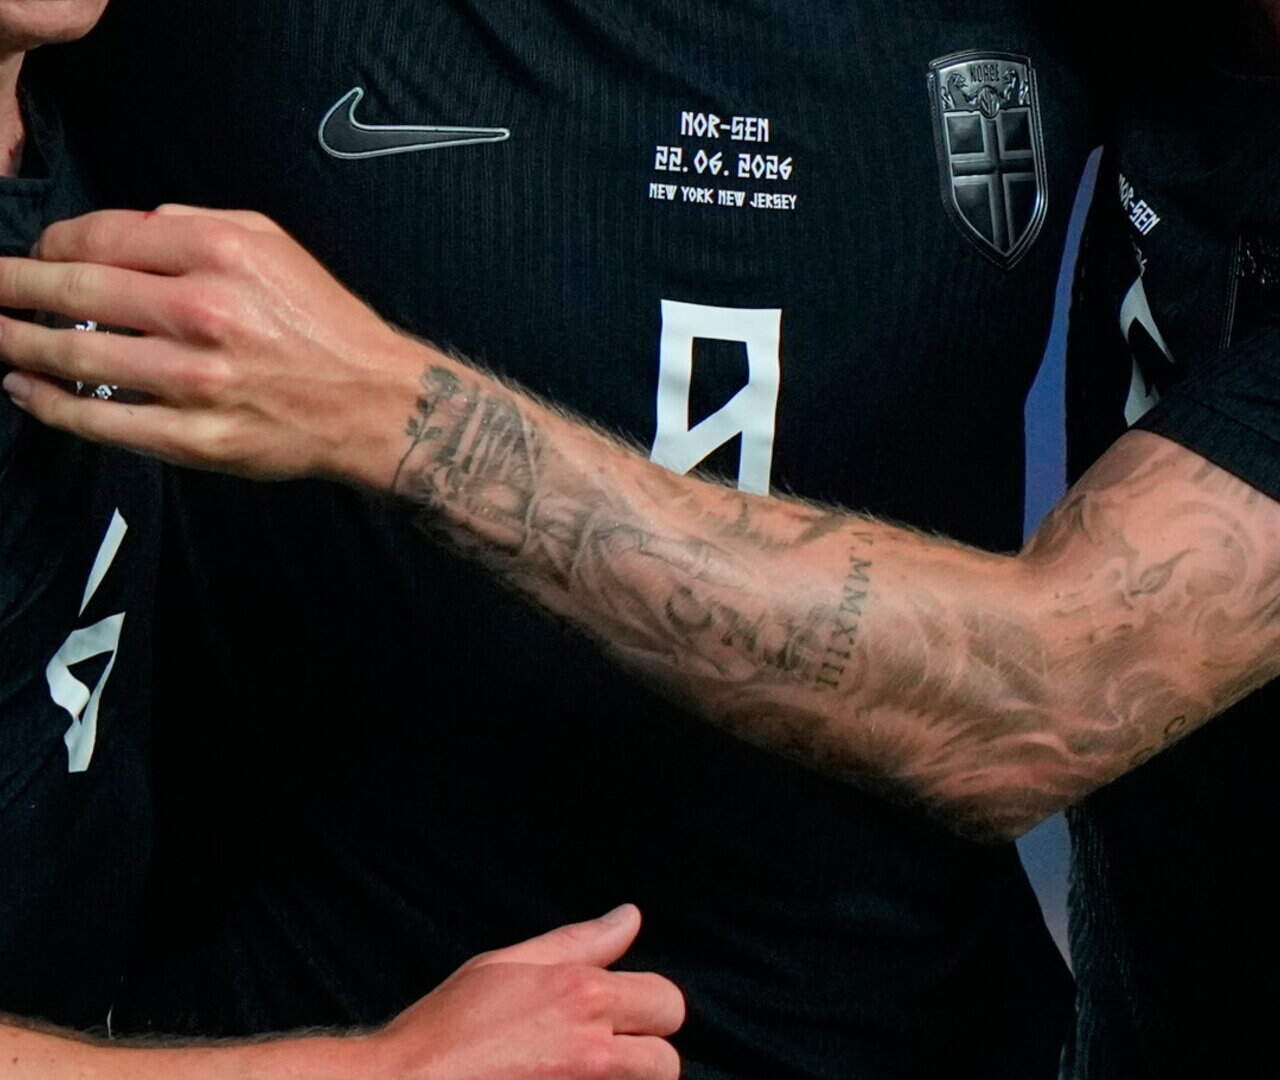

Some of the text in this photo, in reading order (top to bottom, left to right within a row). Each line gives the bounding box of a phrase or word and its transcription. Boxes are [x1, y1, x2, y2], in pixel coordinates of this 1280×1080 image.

[680, 111, 769, 142] NOR-SEN
[649, 183, 797, 210] NEW YORK NEW JERSEY
